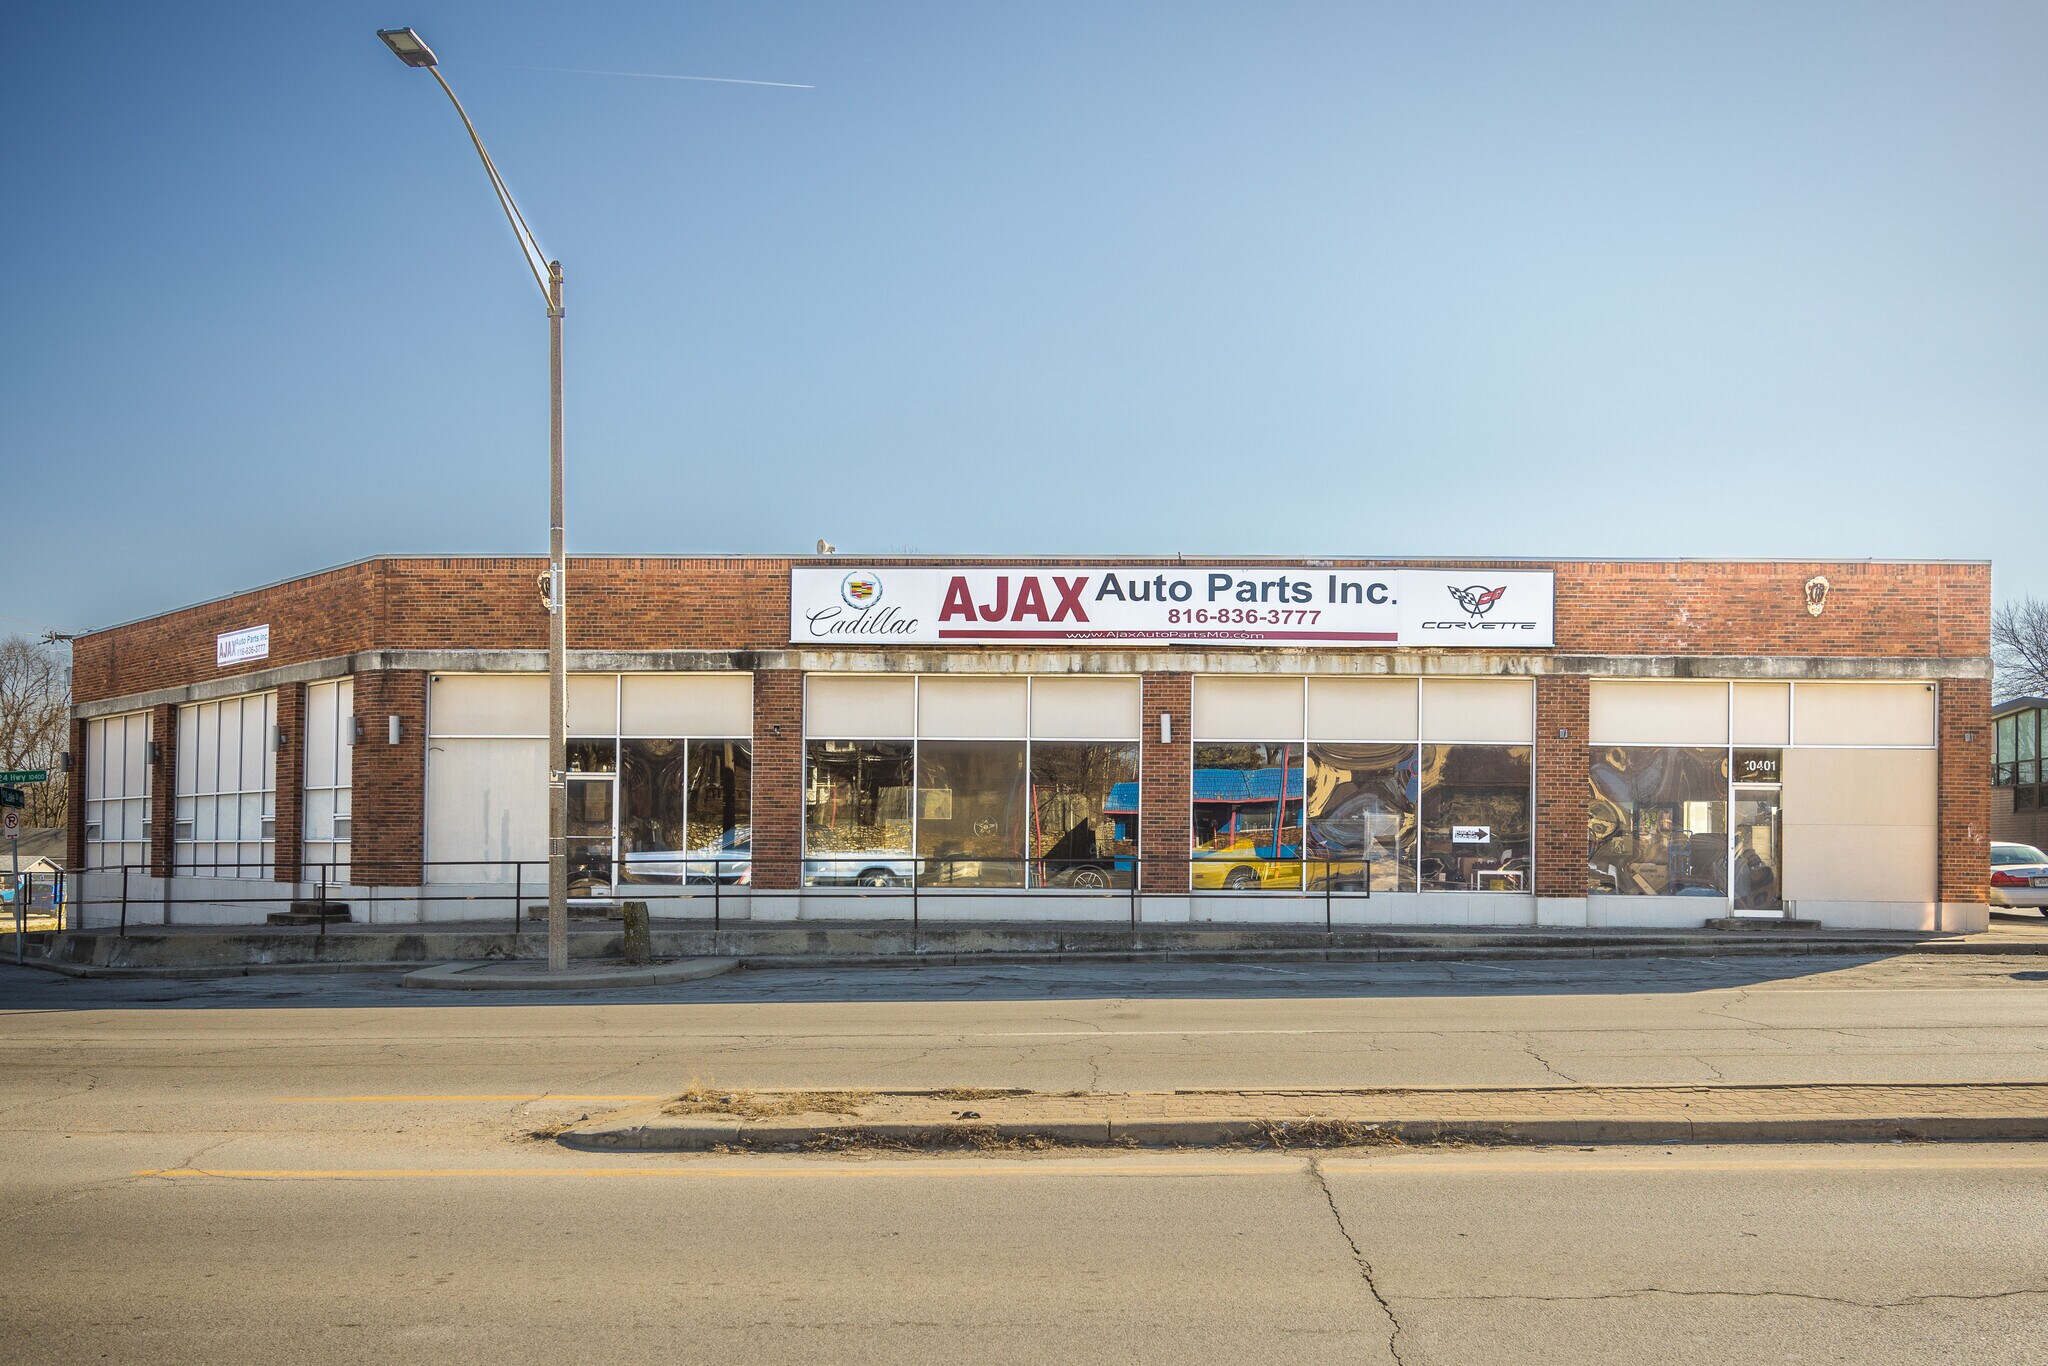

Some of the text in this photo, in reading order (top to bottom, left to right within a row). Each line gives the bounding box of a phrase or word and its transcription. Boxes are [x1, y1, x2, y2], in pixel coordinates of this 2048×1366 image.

[938, 573, 1397, 623] AJAX Auto Parts Inc.
[806, 606, 919, 637] Cadillac
[1168, 608, 1322, 625] 816-836-3777
[1421, 621, 1537, 630] CORVETTE
[247, 635, 259, 643] Parts
[219, 640, 236, 658] AJAX
[10, 773, 26, 782] Hwy
